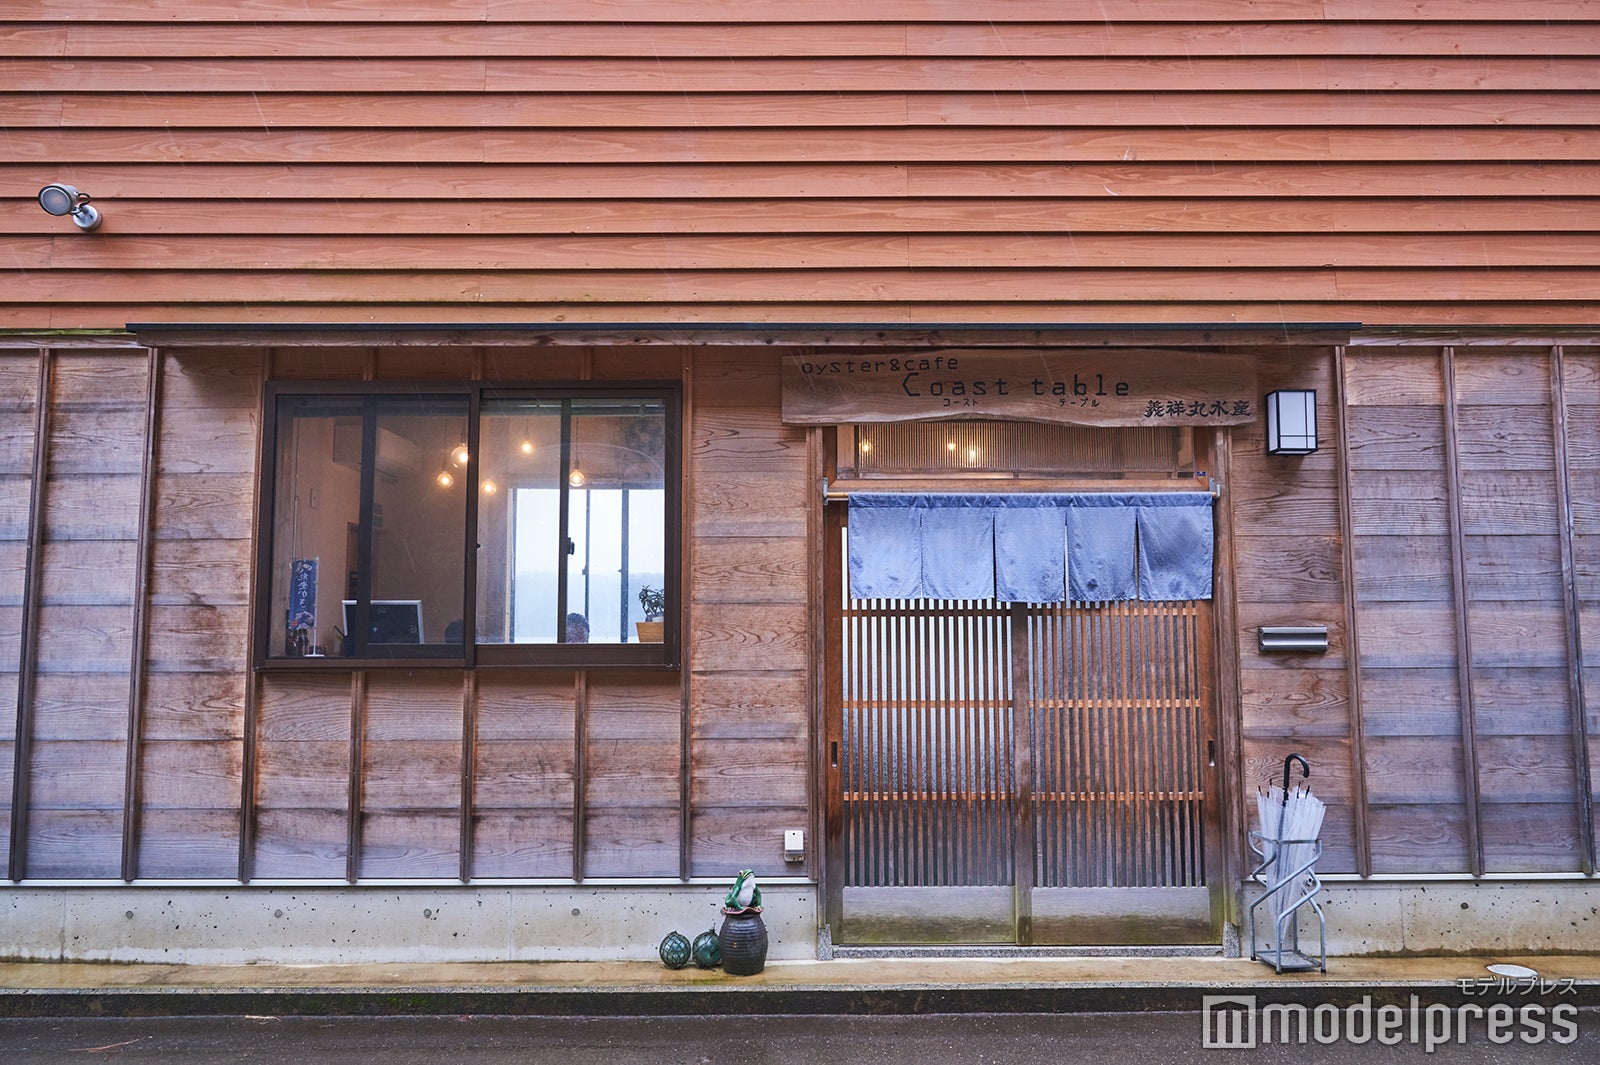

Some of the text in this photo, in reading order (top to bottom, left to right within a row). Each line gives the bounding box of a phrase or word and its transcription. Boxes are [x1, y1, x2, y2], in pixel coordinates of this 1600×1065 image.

[801, 356, 959, 375] oyster&cafe
[902, 372, 1130, 398] Coast table
[943, 398, 1100, 408] コースト テーブル
